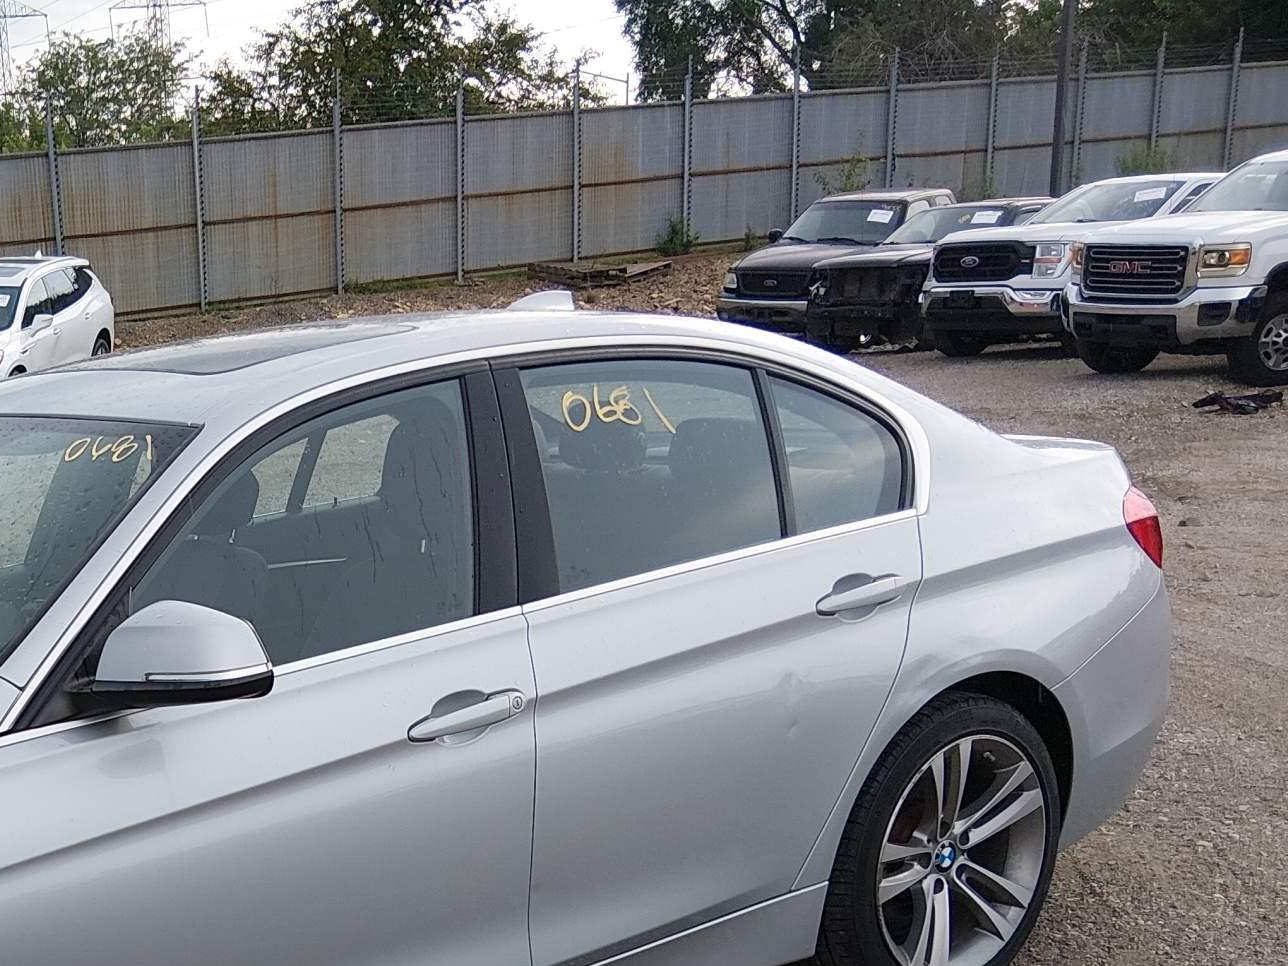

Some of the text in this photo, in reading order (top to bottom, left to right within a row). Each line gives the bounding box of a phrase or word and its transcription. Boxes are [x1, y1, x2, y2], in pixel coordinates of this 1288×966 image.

[1110, 261, 1152, 274] GMC
[561, 383, 677, 433] 0681
[64, 434, 152, 462] 0681
